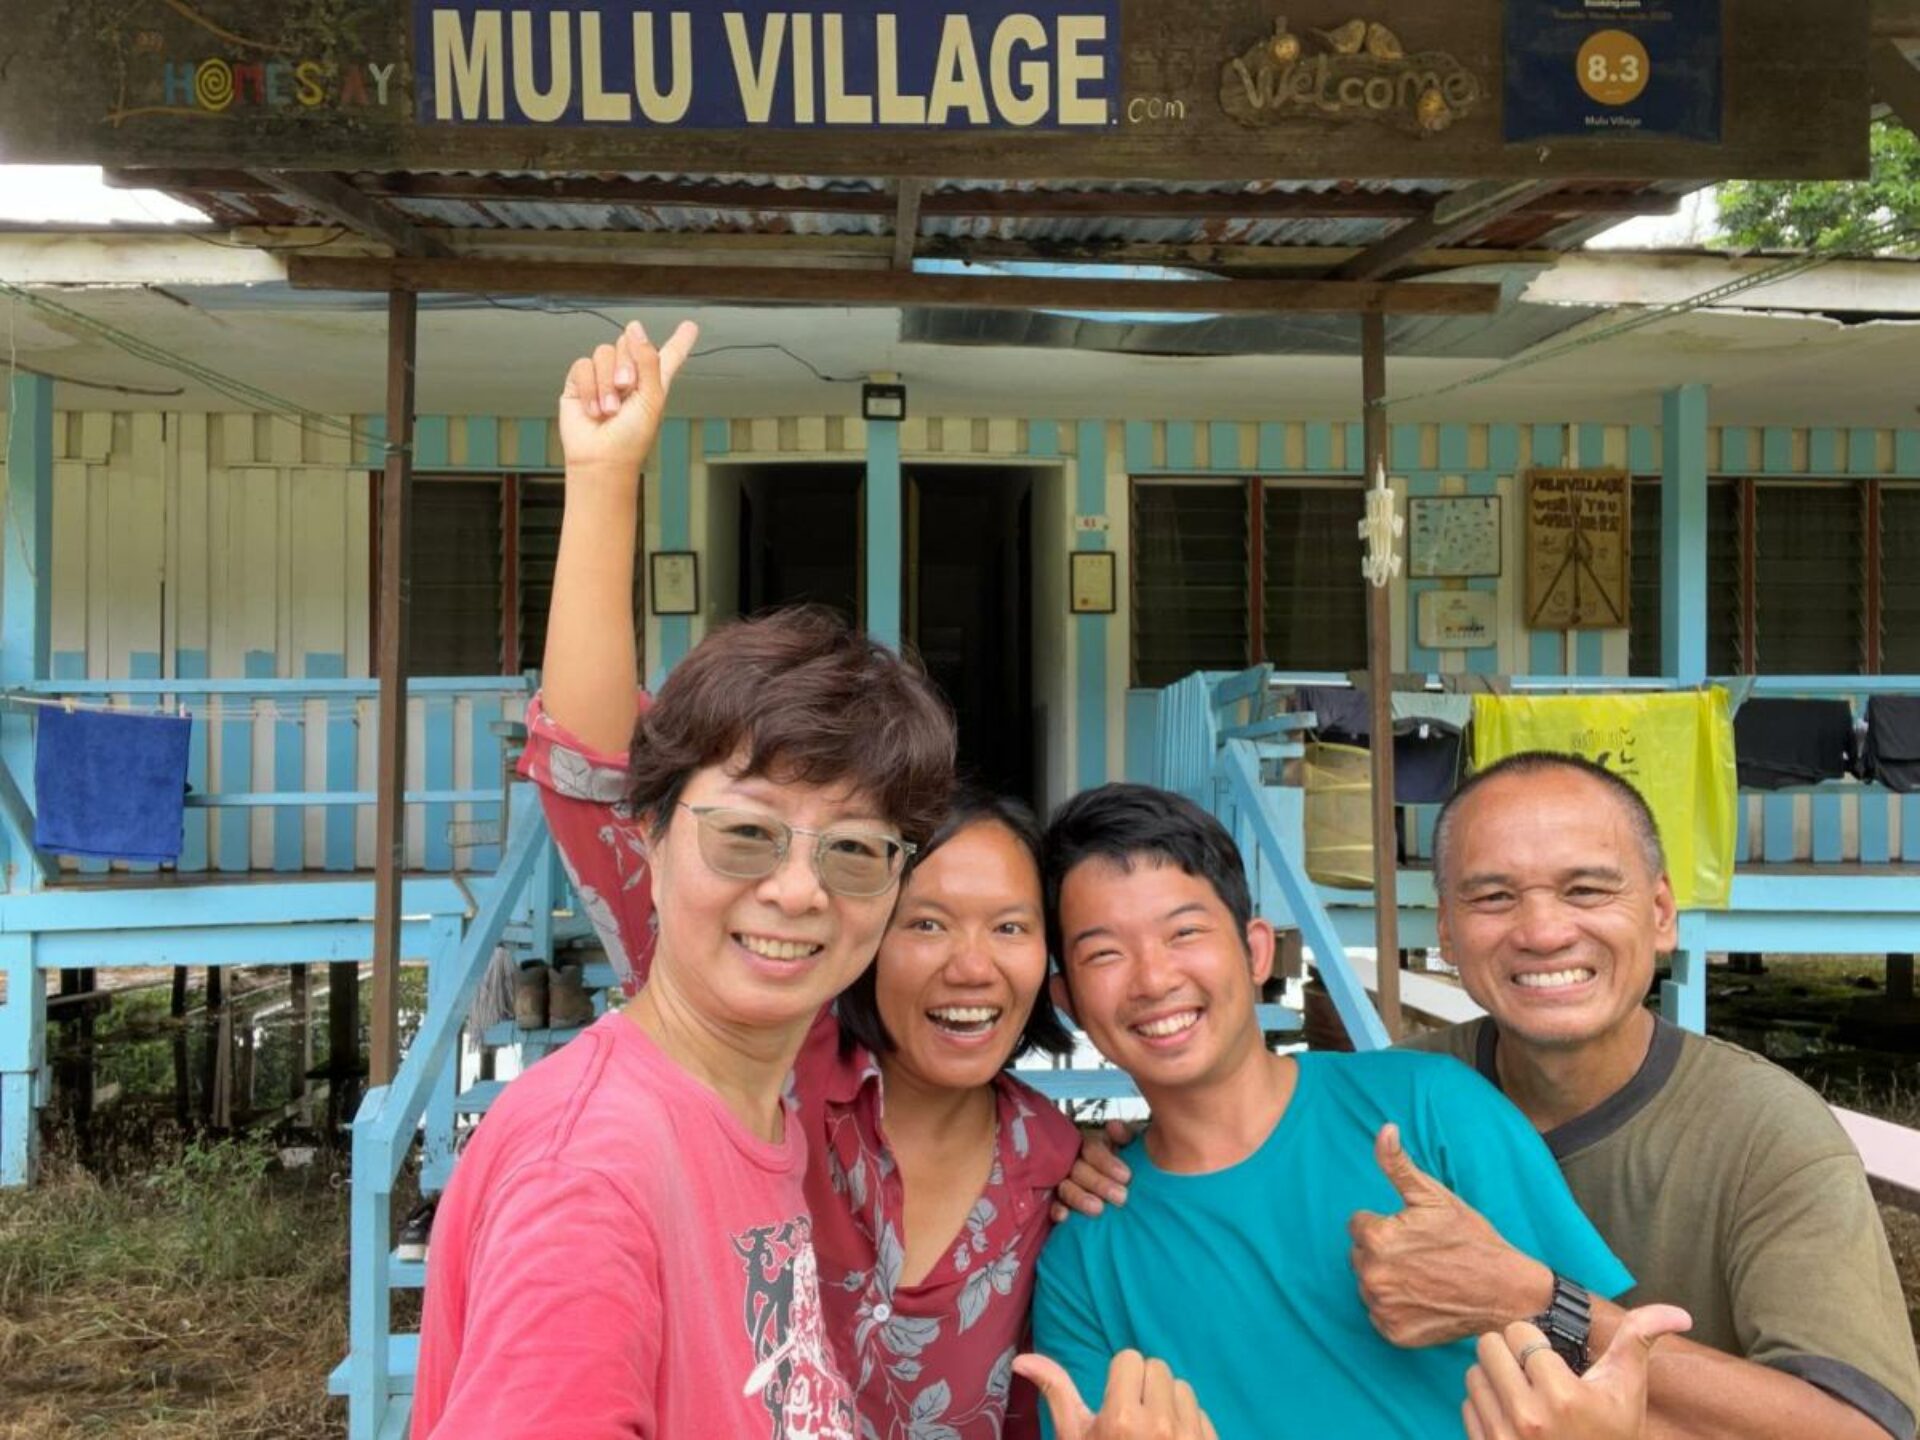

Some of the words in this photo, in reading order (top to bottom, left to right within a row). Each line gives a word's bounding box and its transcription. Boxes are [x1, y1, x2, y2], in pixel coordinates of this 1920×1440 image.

[163, 57, 396, 111] HOMESAY
[432, 8, 694, 124] MULU
[722, 12, 1108, 126] VILLAGE
[1231, 53, 1476, 113] Welcome
[1587, 54, 1640, 83] 8.3
[1585, 115, 1609, 126] Mulu
